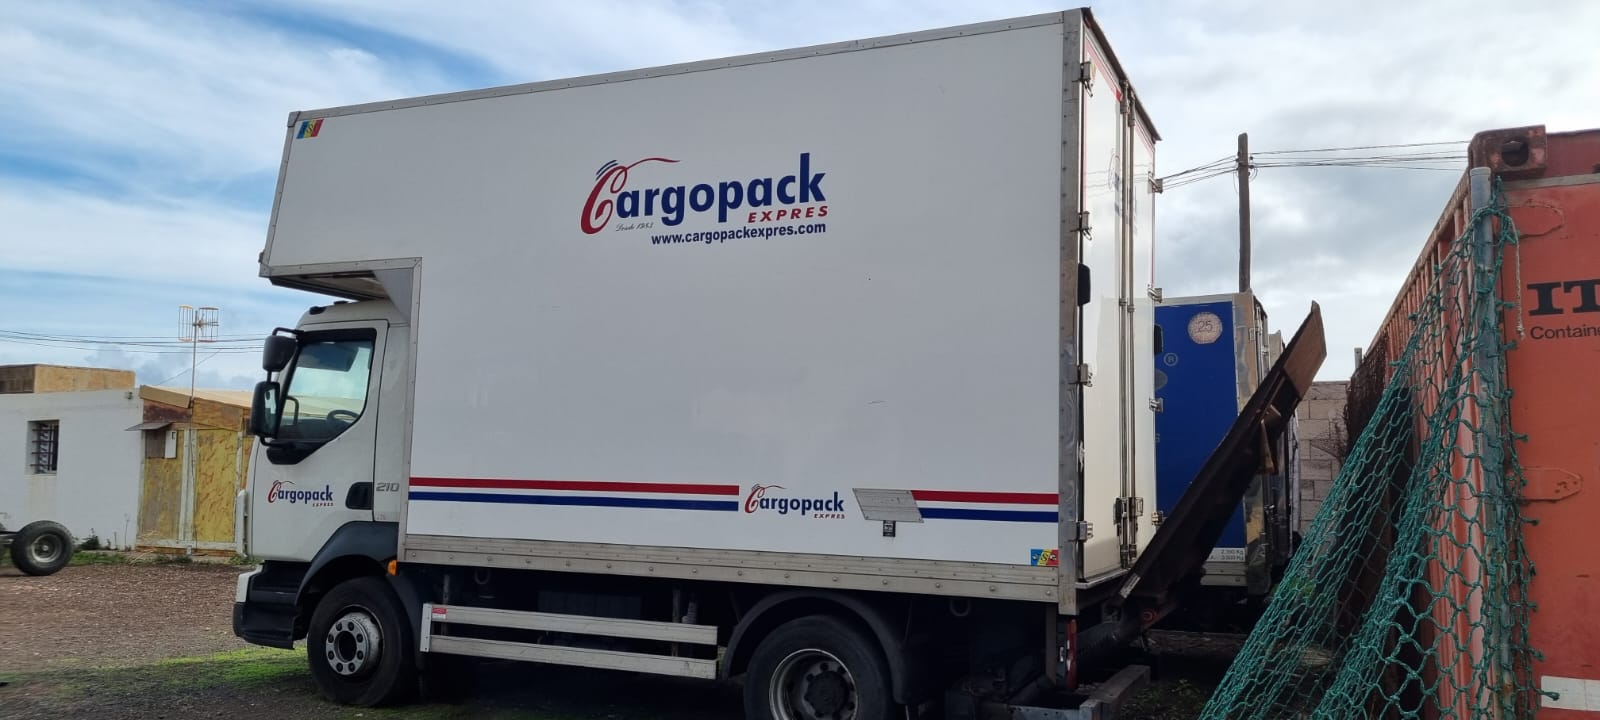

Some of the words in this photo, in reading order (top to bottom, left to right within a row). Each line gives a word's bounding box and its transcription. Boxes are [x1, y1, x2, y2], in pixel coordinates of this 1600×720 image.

[581, 152, 826, 234] Cargopack
[748, 206, 828, 223] EXPRES
[651, 223, 826, 245] www.cargopackexpres.com
[267, 480, 333, 504] Cargopack
[376, 482, 399, 492] 210
[744, 485, 844, 515] Cargopack
